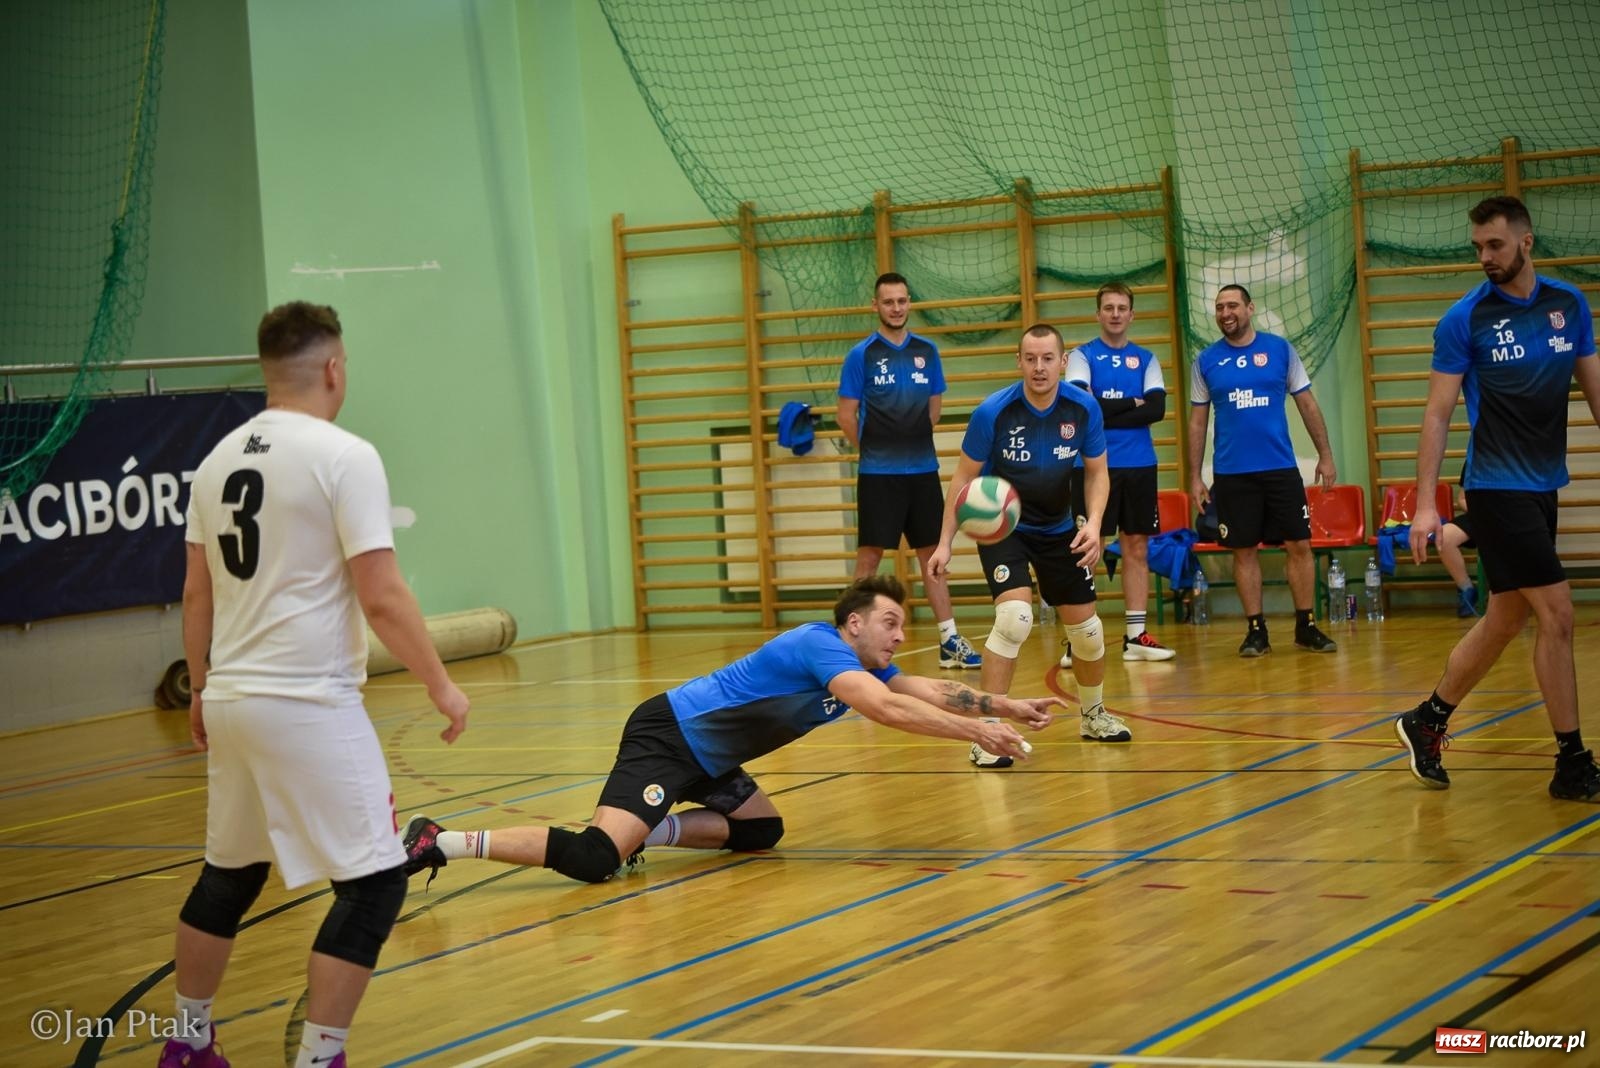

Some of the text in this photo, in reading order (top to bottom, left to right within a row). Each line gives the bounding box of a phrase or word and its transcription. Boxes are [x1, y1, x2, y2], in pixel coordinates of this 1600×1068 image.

[1495, 330, 1515, 345] 18
[1492, 345, 1526, 362] M.D
[1111, 355, 1122, 368] 5
[1235, 355, 1247, 368] 6
[880, 364, 888, 374] 8
[874, 374, 896, 385] M.K
[1228, 387, 1253, 403] eko
[1009, 437, 1025, 449] 15
[1002, 449, 1031, 462] M.D
[217, 468, 265, 582] 3
